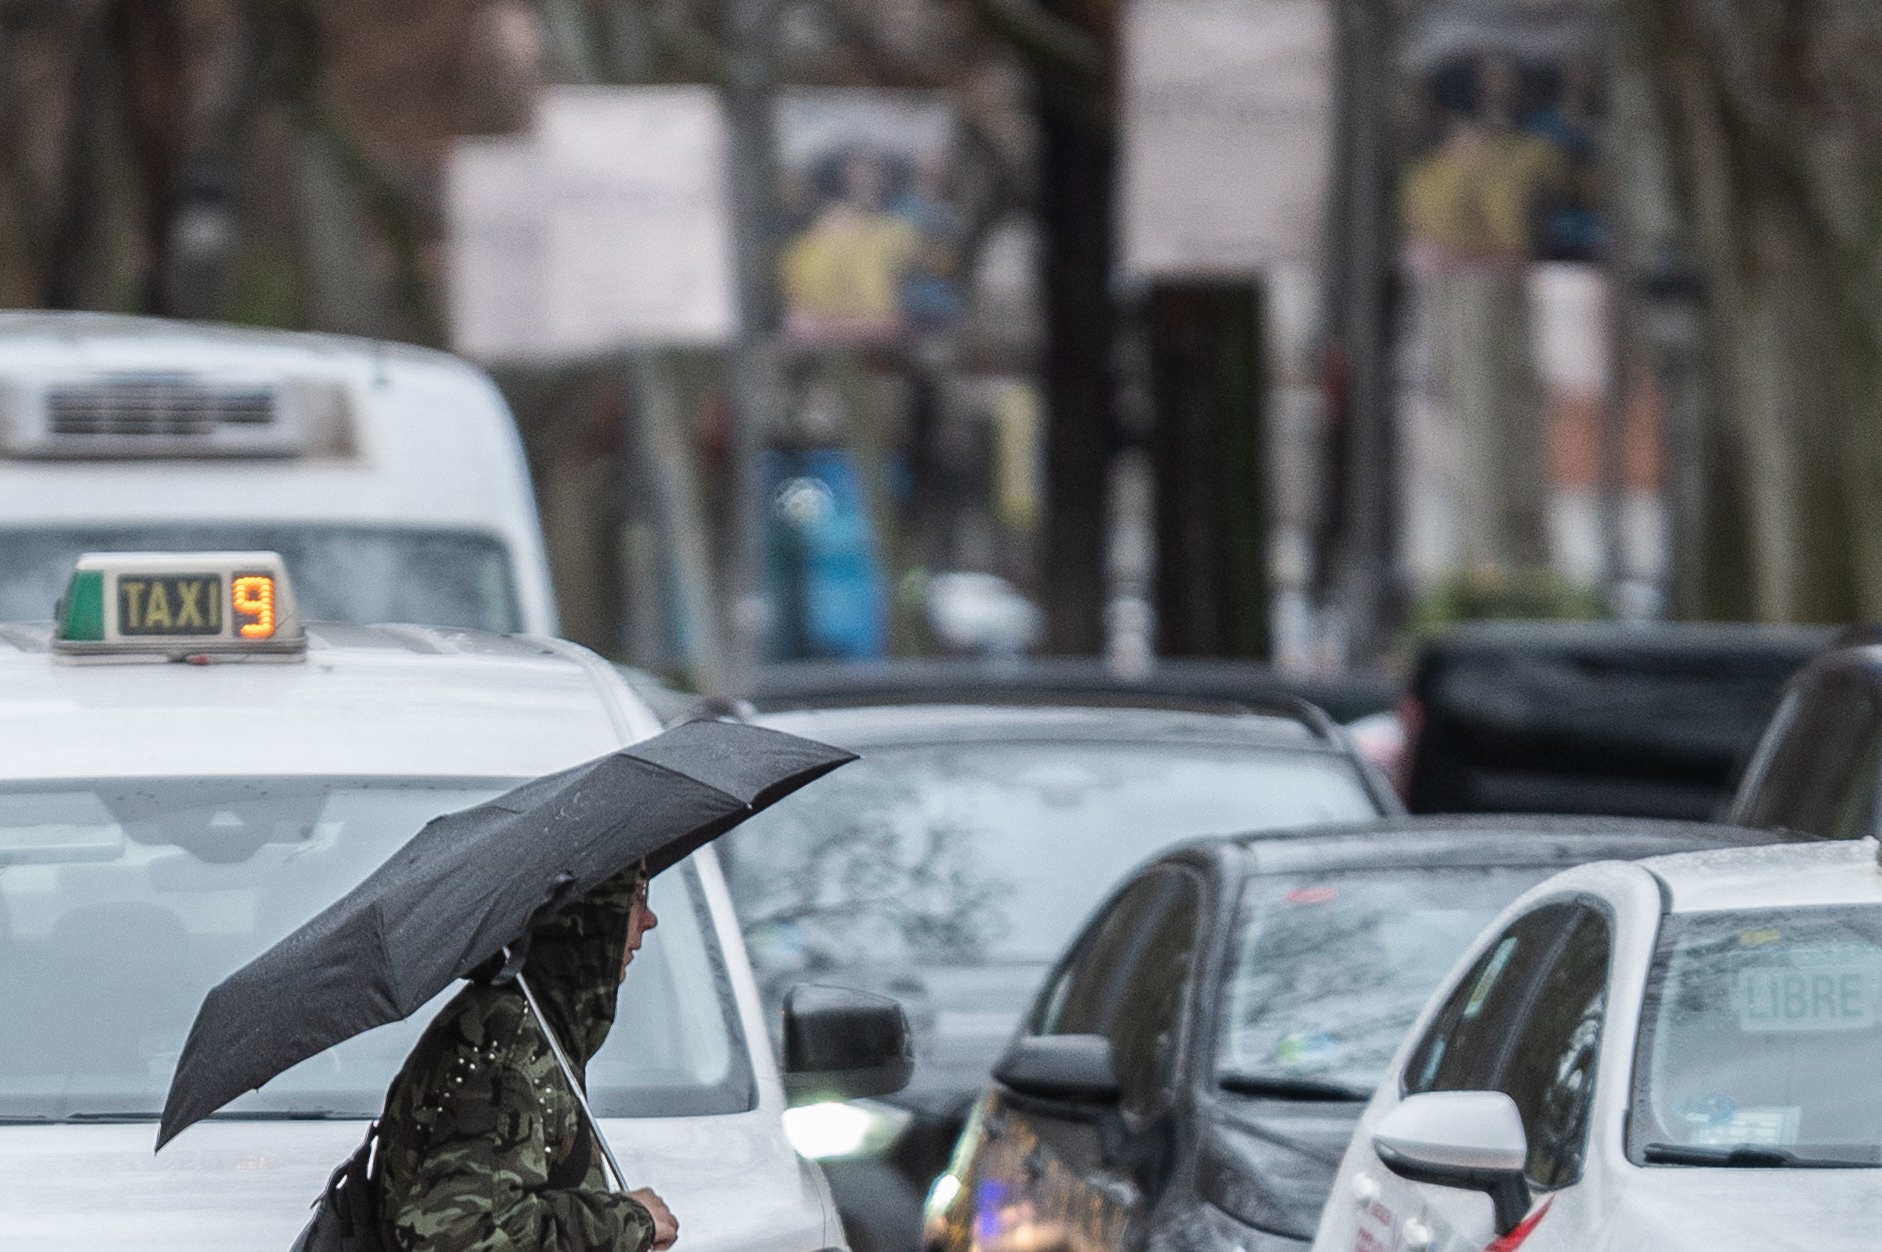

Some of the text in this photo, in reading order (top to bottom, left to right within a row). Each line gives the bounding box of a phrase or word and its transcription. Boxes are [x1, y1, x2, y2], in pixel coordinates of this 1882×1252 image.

[122, 581, 219, 628] TAXI
[233, 576, 274, 638] 9
[1747, 973, 1864, 1020] LIBRE
